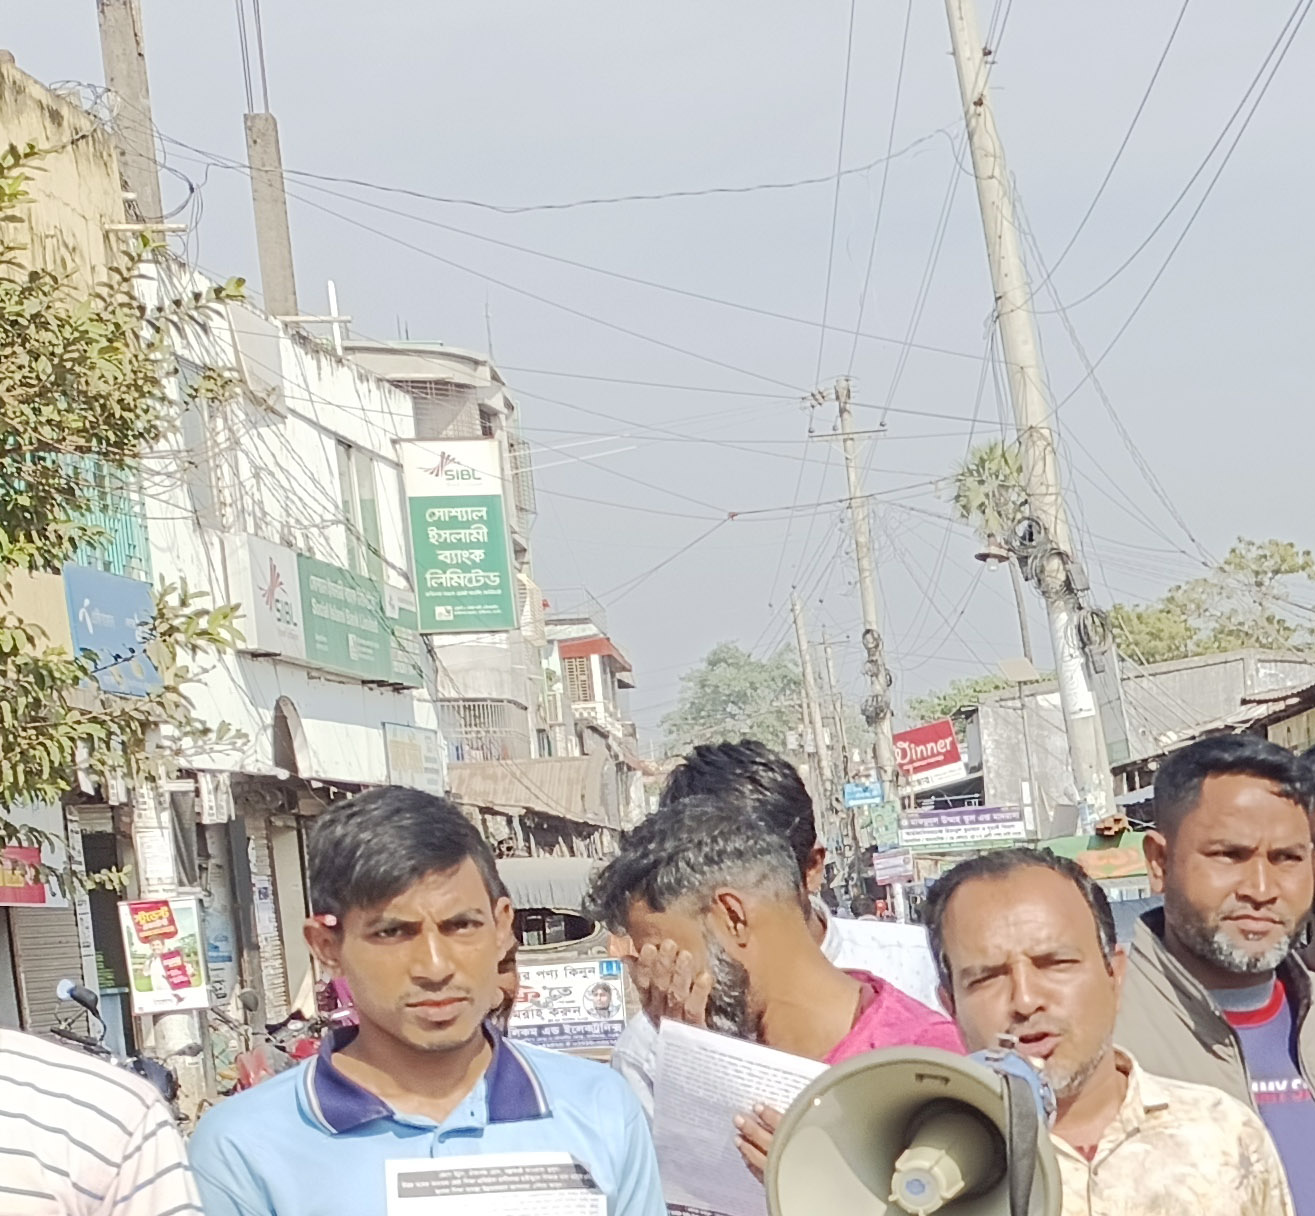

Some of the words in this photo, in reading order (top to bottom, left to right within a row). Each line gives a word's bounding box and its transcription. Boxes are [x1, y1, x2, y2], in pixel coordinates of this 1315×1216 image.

[444, 469, 482, 481] SIBL
[425, 506, 488, 523] সোশ্যাল
[427, 524, 489, 545] ইসলামী
[436, 549, 486, 565] ব্যাংক
[425, 568, 501, 588] লিমিটেড
[893, 737, 953, 764] Winner
[563, 965, 596, 979] কিনুন
[549, 1006, 581, 1018] করুন
